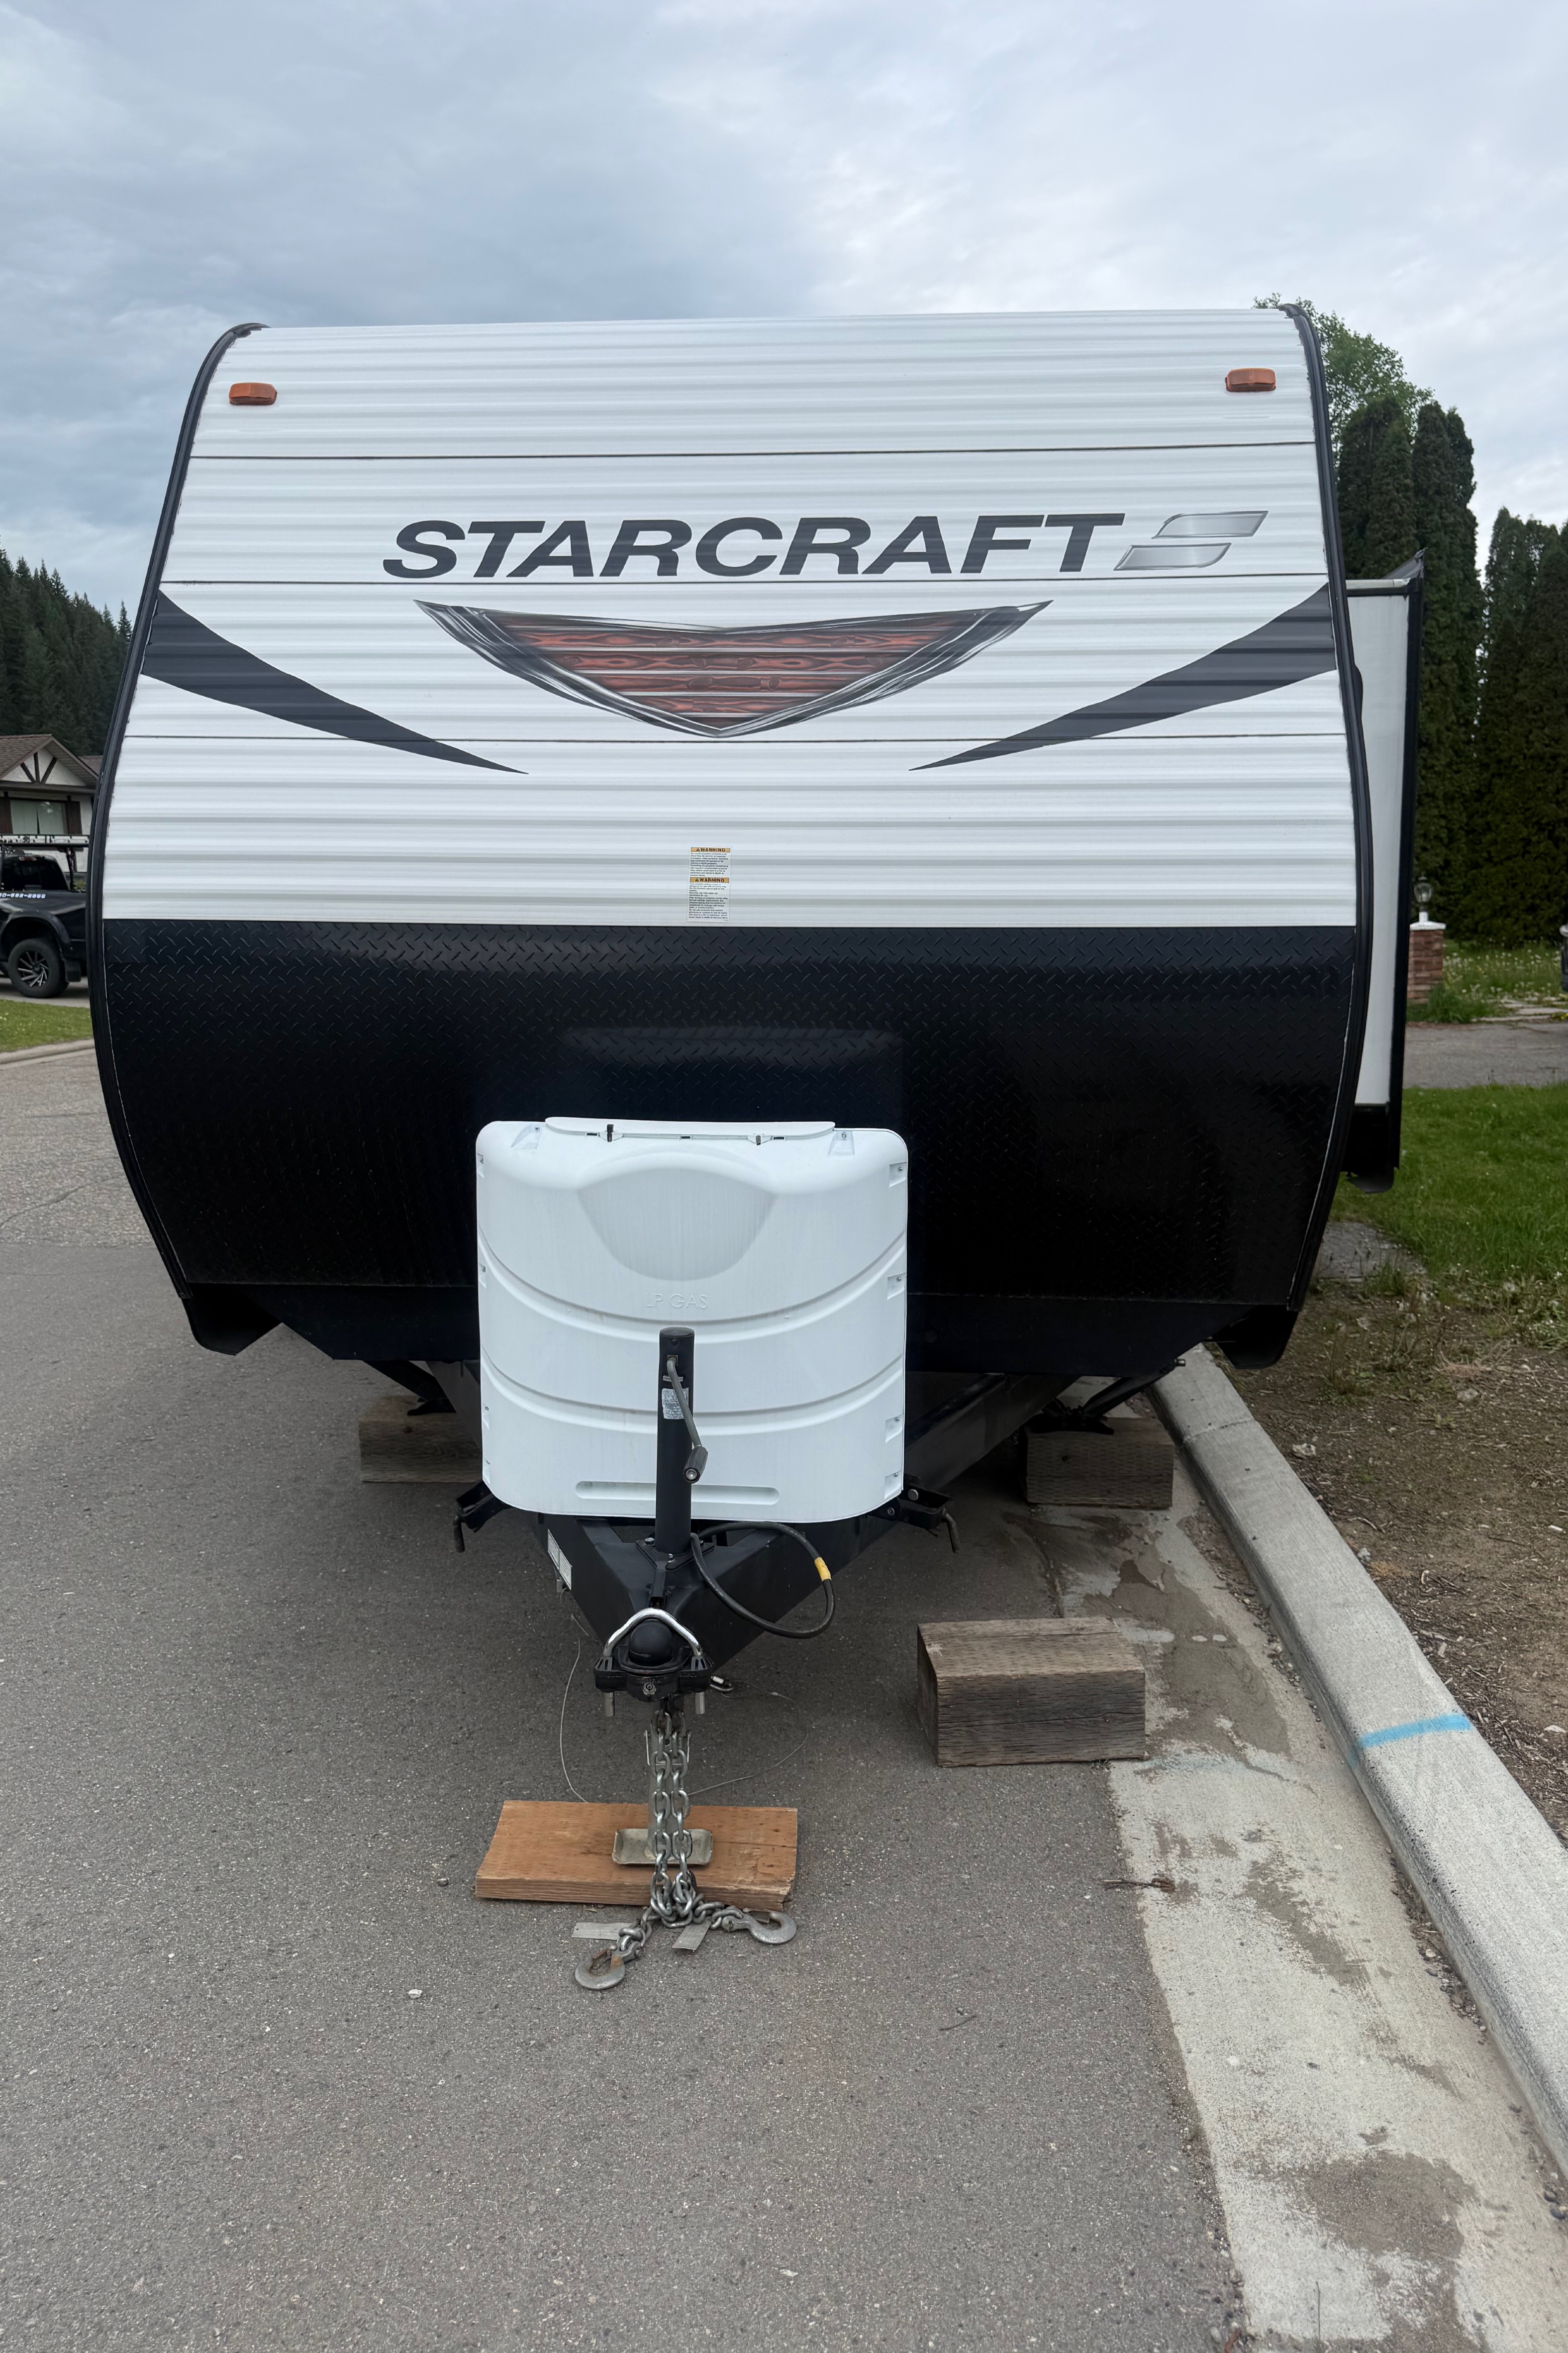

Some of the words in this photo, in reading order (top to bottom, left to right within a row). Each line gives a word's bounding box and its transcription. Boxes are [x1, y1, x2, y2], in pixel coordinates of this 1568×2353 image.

[383, 513, 1125, 579] STARCRAFT
[645, 1293, 664, 1308] LP
[670, 1293, 708, 1309] GAS
